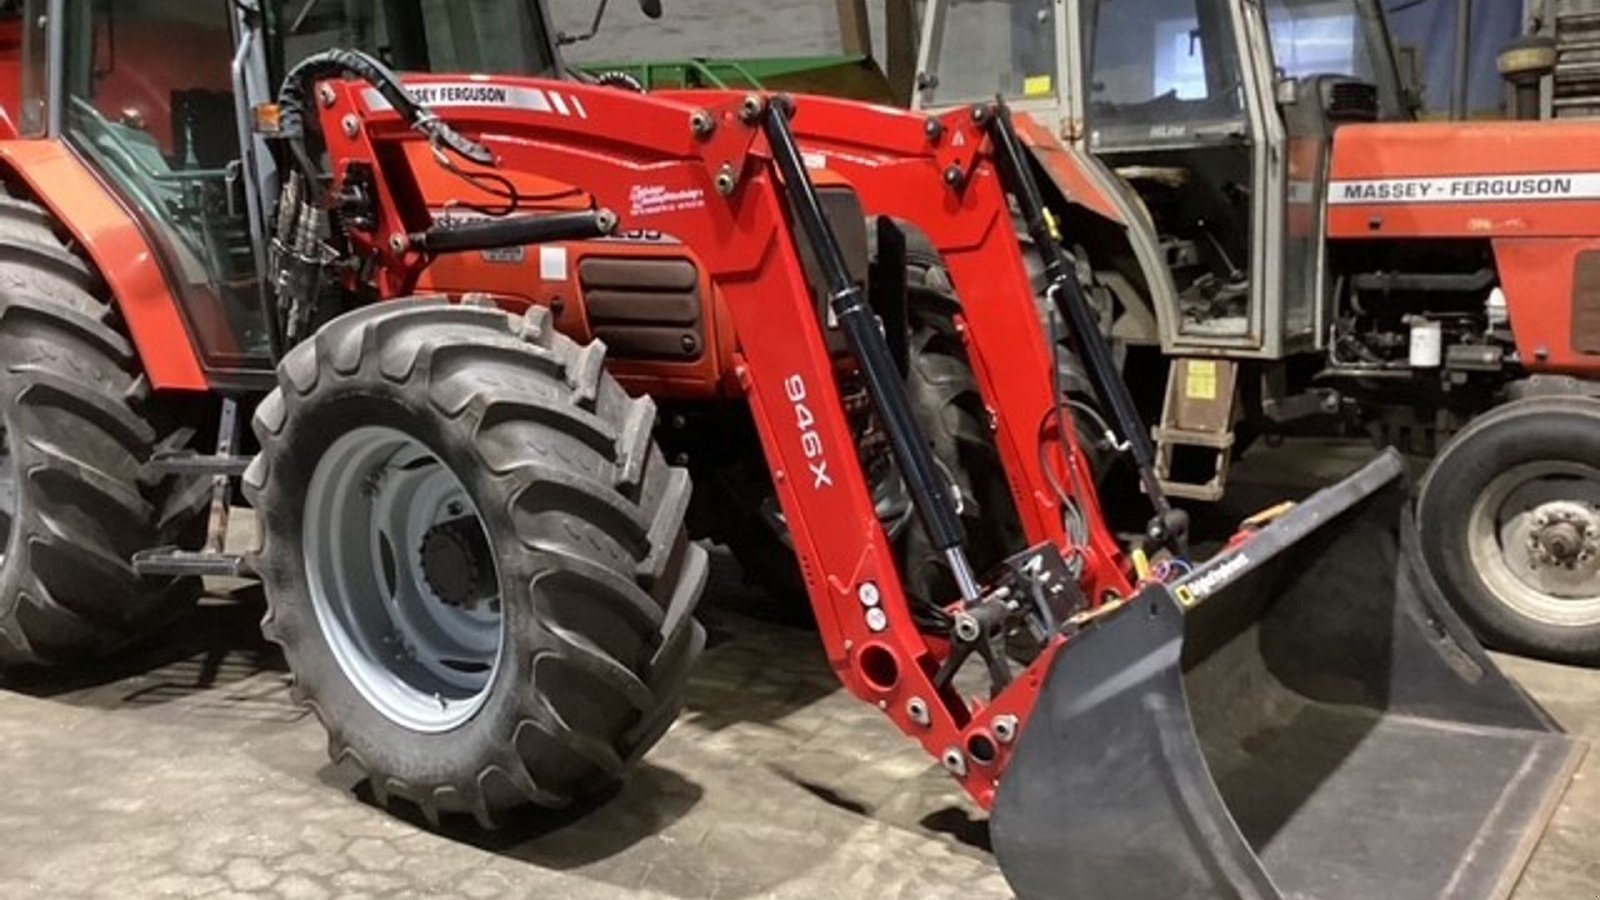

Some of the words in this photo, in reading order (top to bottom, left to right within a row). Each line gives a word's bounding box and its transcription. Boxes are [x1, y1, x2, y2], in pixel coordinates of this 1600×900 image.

[439, 87, 506, 103] FERGUSON
[1343, 182, 1432, 199] MASSEY
[1450, 178, 1571, 196] FERGUSON
[784, 373, 834, 490] 946X
